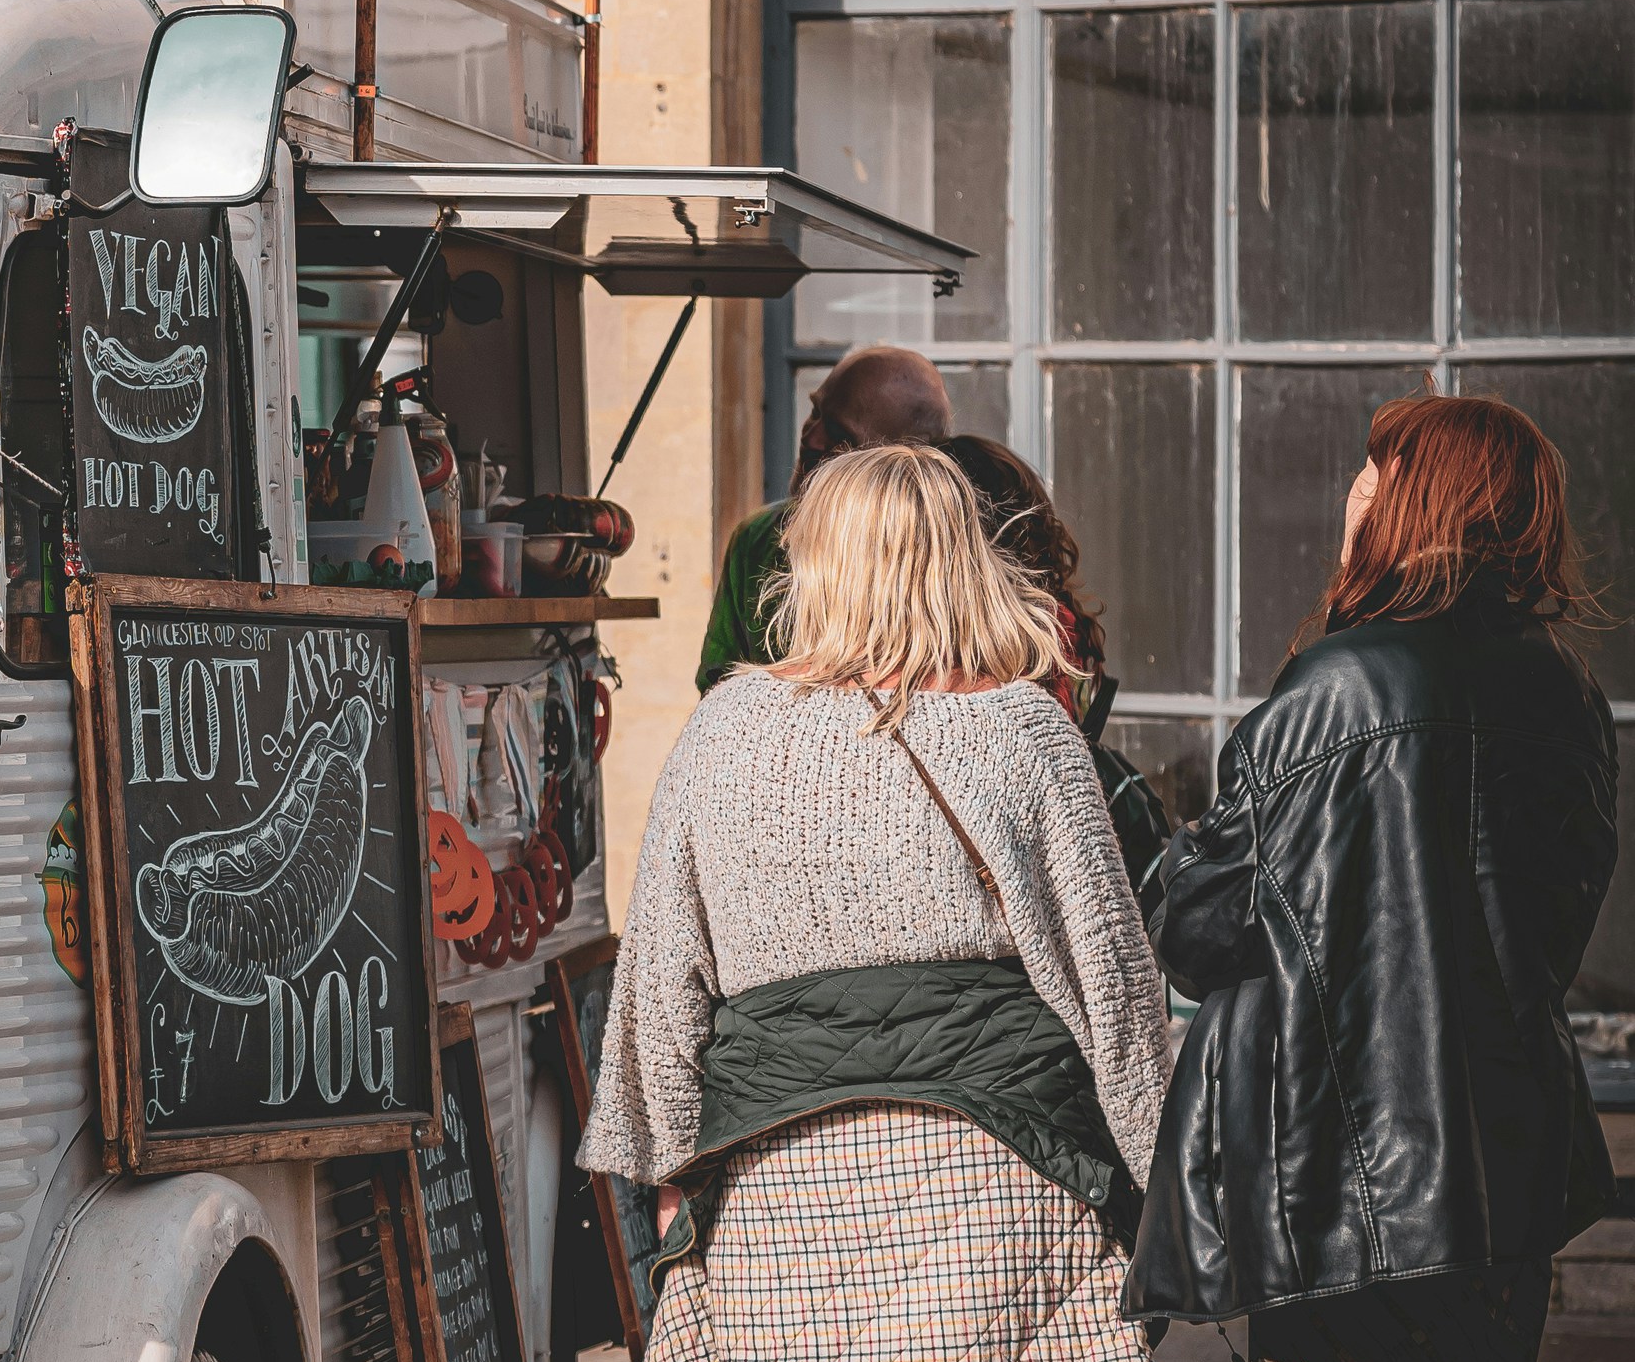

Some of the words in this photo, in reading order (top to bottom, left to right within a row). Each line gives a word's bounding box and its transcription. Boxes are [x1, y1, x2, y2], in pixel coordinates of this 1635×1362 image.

[89, 228, 223, 341] VEGAN
[82, 457, 143, 509] HOT
[149, 461, 225, 545] DOG
[118, 619, 213, 652] GLOUCESTER
[214, 625, 235, 647] OLD
[239, 626, 277, 652] SPOT
[124, 655, 261, 788] HOT
[259, 956, 406, 1110] DOG
